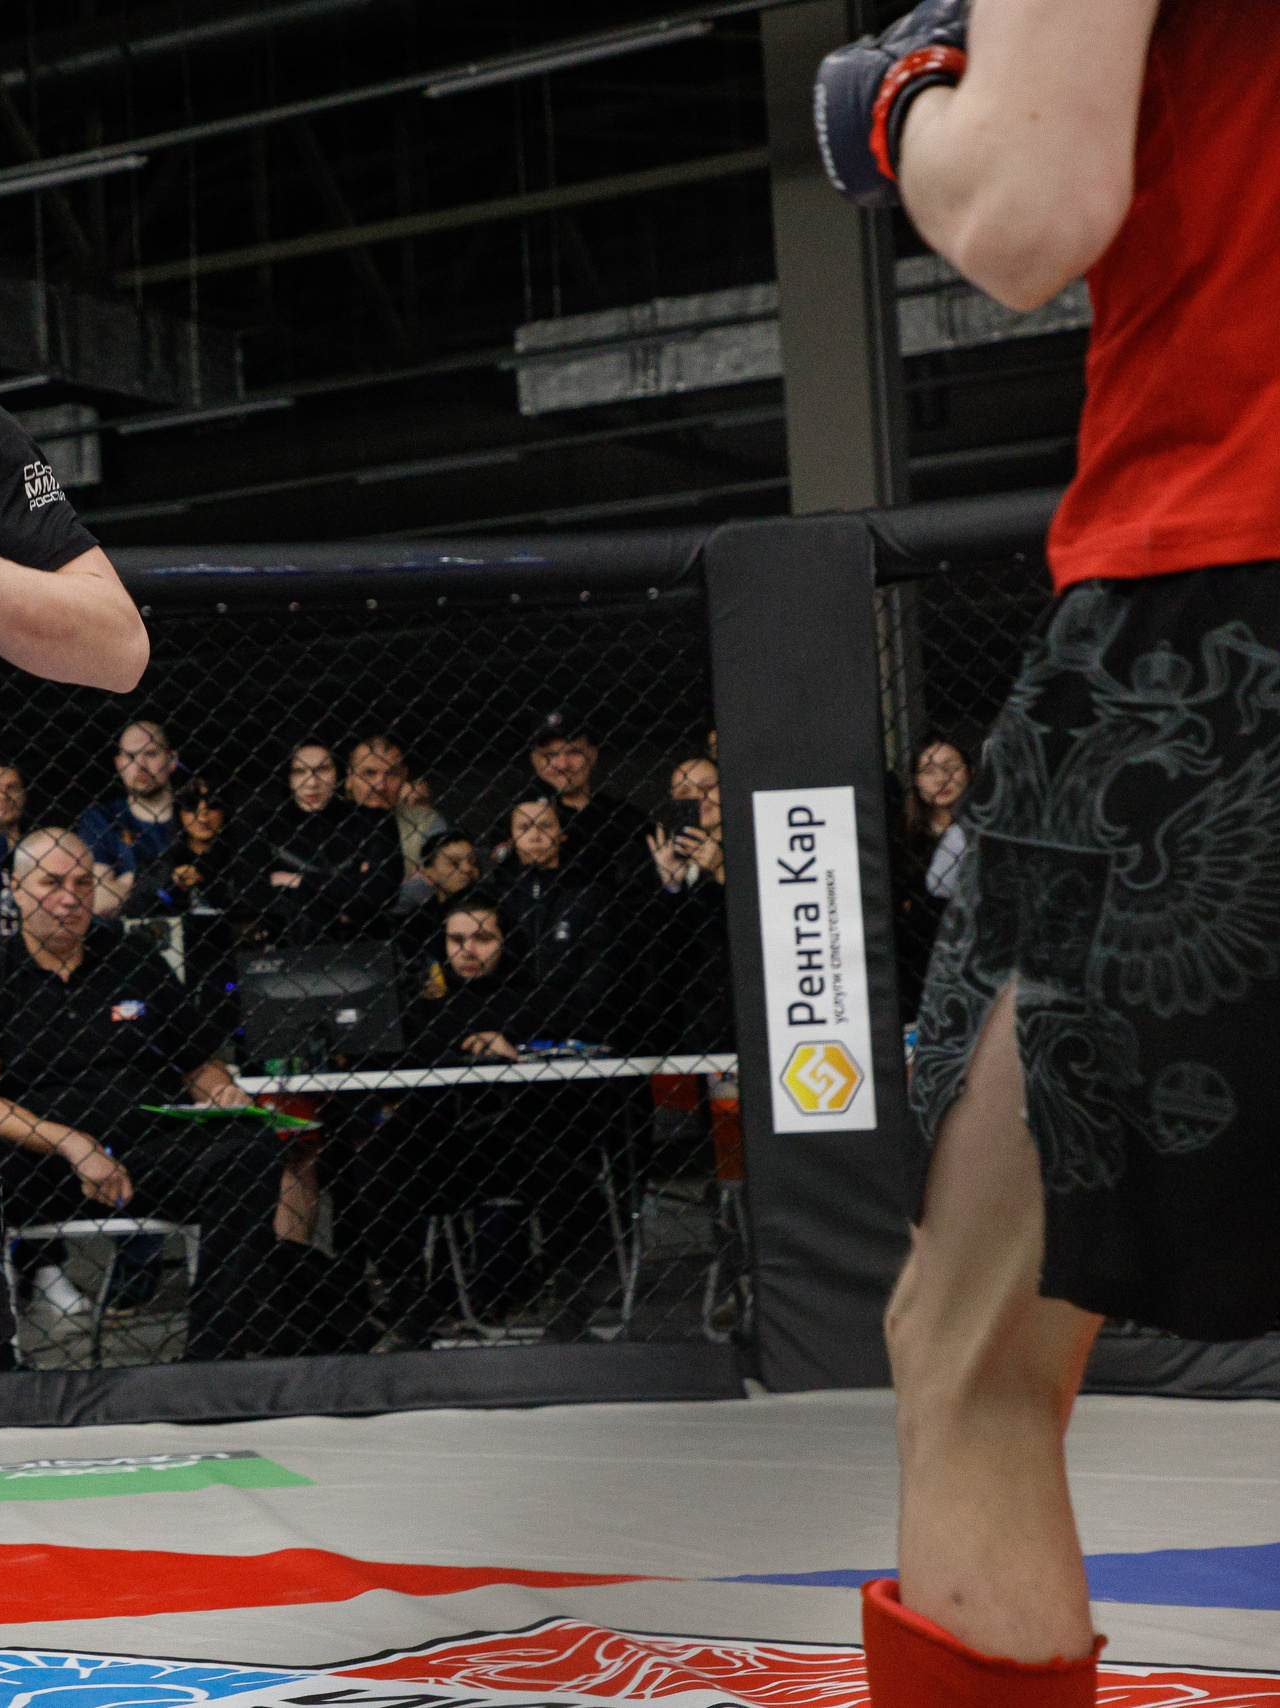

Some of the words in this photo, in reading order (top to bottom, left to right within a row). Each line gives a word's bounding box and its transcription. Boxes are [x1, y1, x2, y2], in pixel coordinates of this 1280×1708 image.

[777, 805, 826, 884] Кар
[787, 902, 827, 1027] Рента
[832, 973, 849, 1025] услуги
